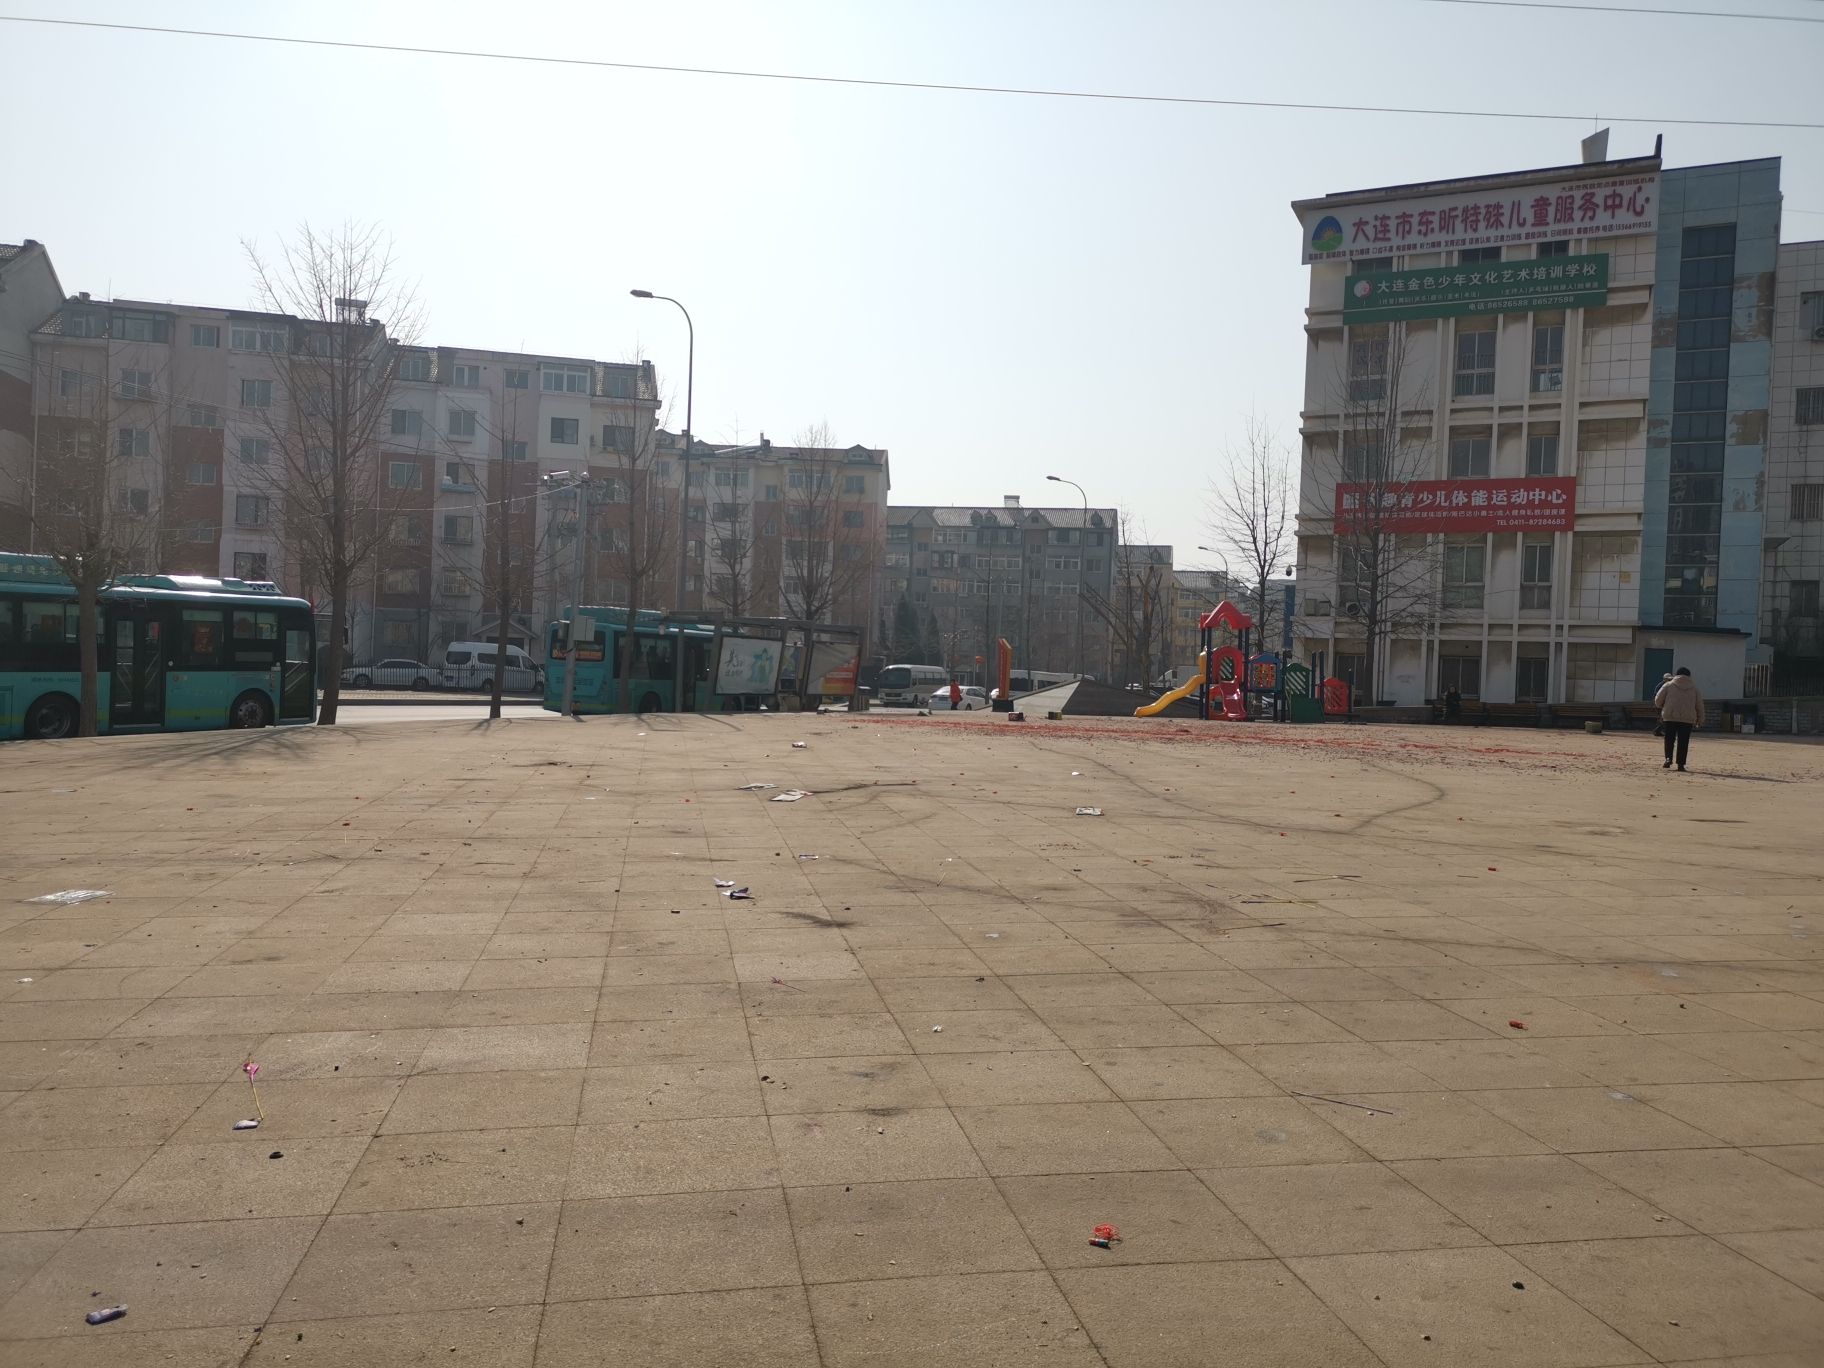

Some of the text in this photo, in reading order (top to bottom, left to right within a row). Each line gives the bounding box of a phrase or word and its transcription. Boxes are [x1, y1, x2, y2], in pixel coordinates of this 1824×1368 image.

[1351, 185, 1651, 243] 大连市东昕特殊儿童服务中心
[1376, 263, 1598, 293] 大连金色少年文化艺术培训学校
